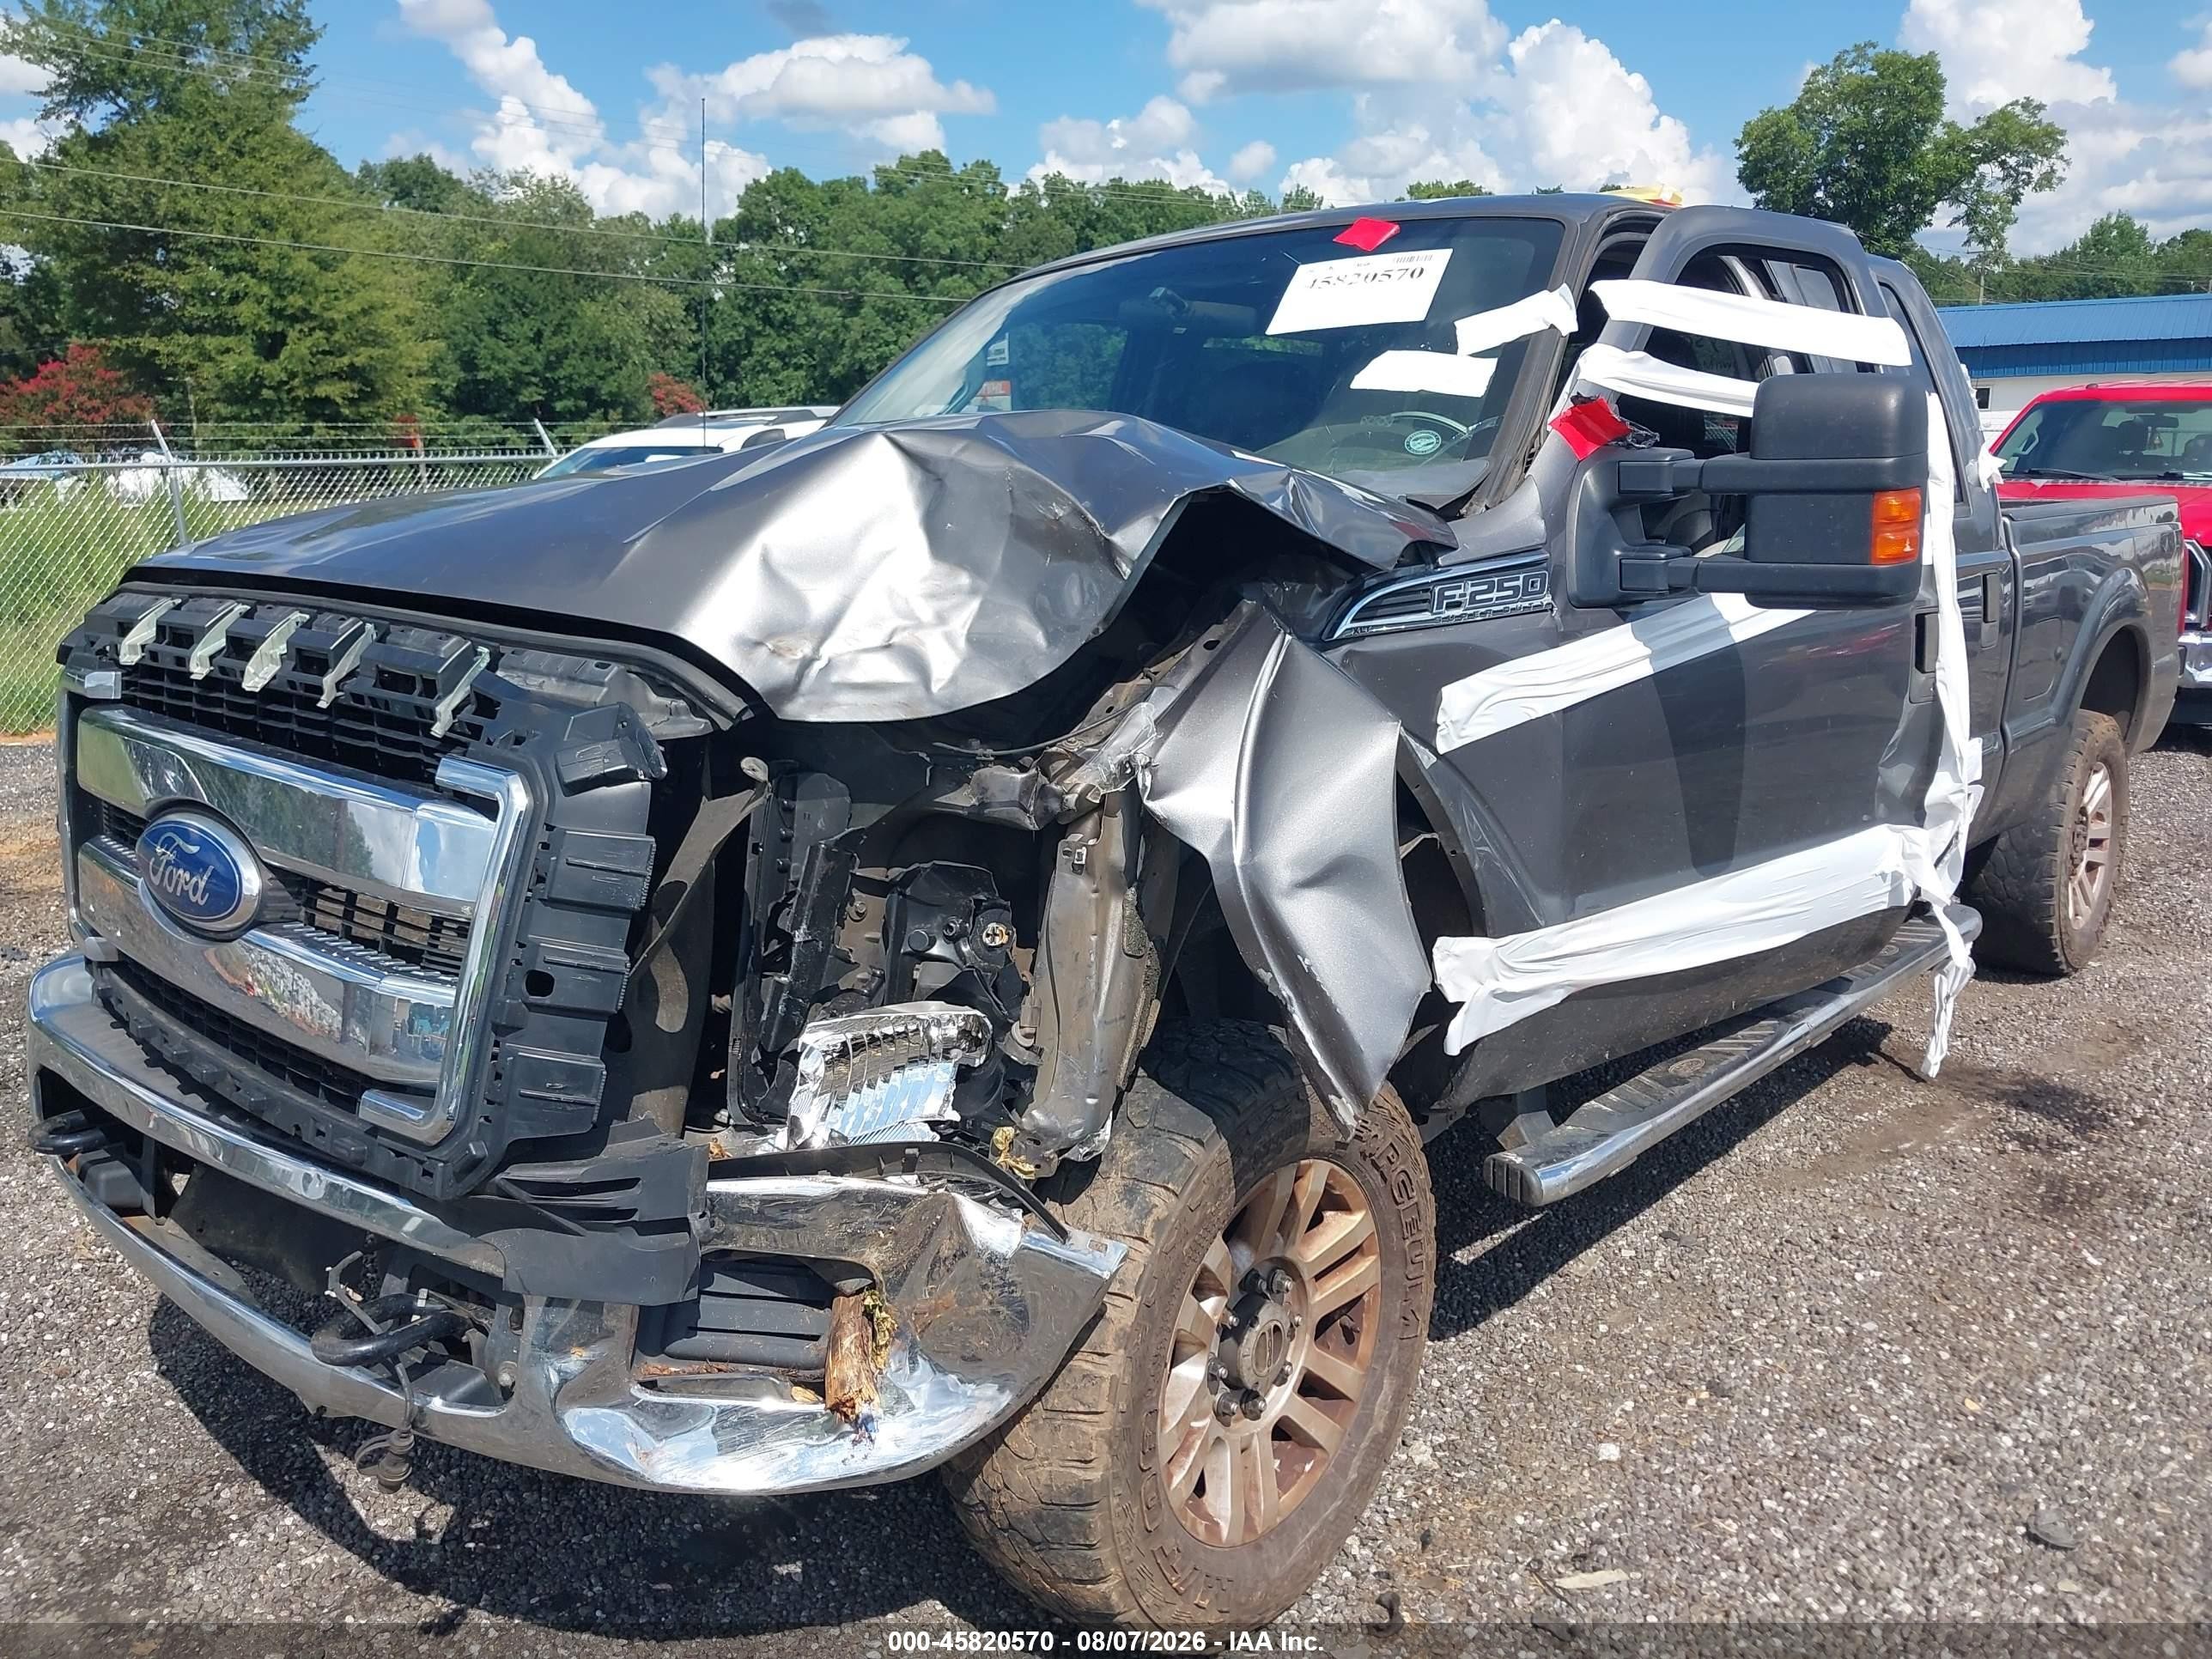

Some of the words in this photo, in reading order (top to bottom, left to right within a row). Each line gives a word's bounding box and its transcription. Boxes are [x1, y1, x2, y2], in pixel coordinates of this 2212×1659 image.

[1432, 571, 1549, 615] F-250
[1435, 608, 1494, 623] SUPER
[1502, 601, 1553, 615] DUTY
[1352, 626, 1372, 636] XLT
[149, 831, 215, 906] Ford
